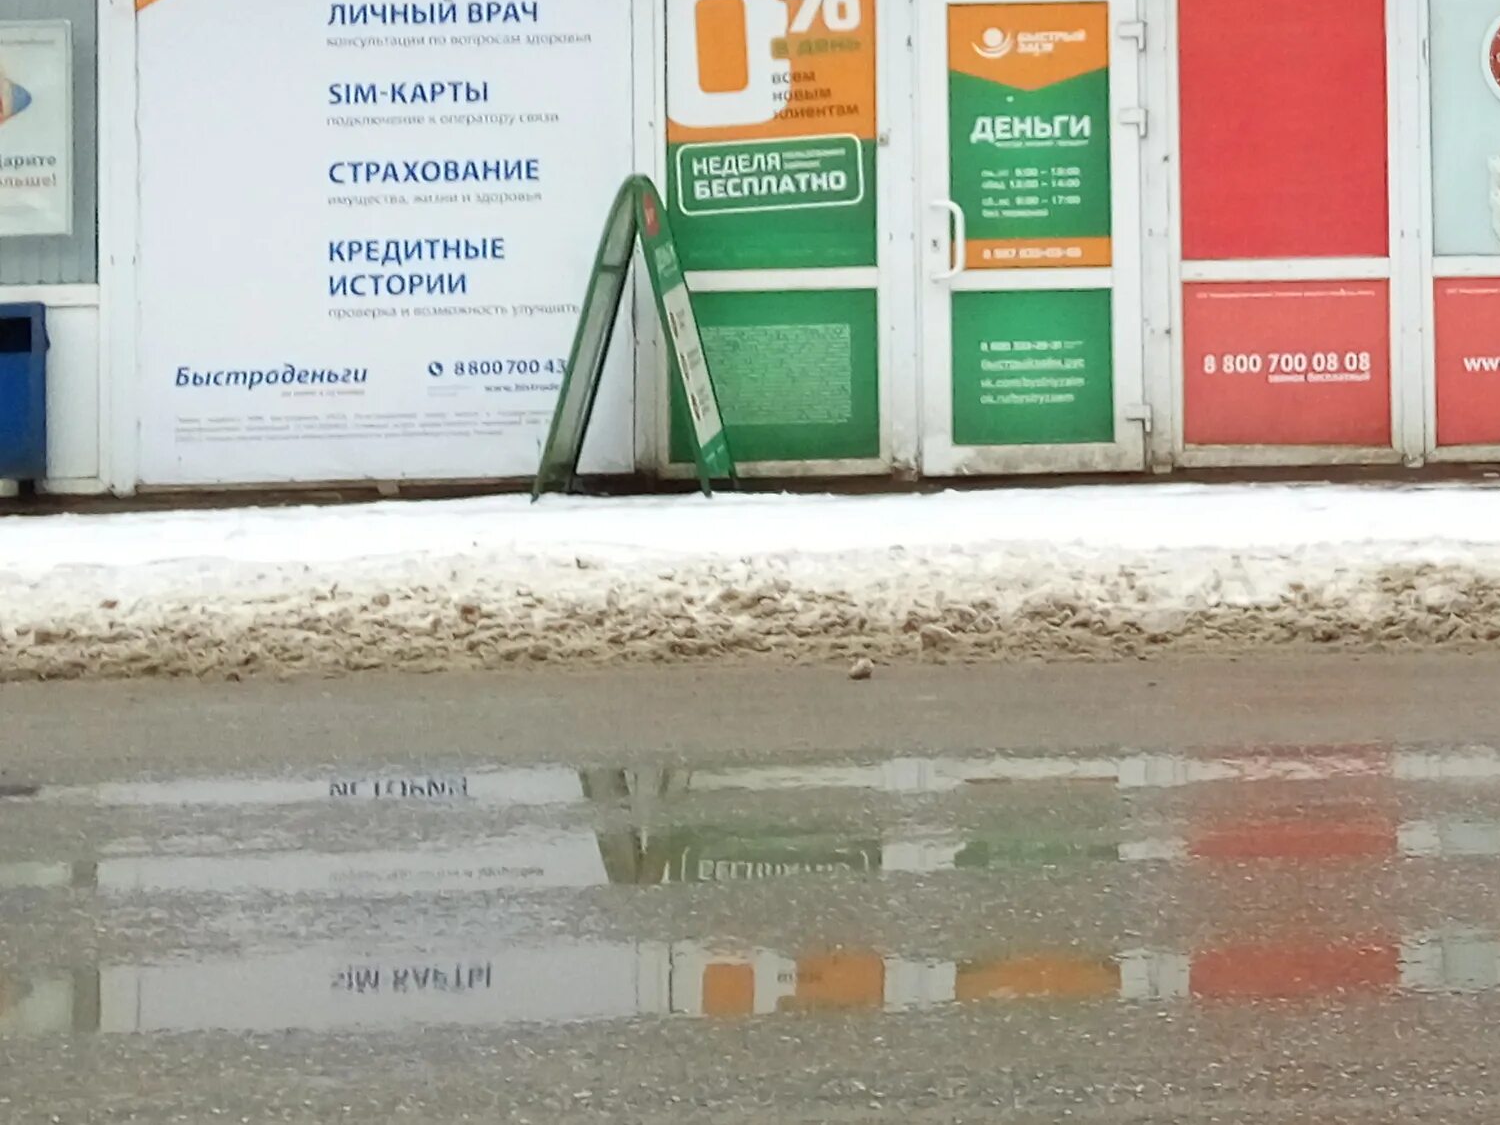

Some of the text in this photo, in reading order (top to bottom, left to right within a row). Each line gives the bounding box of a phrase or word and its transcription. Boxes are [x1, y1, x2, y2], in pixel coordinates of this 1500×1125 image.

[468, 1, 538, 23] ВРАЧ
[328, 81, 489, 105] SIM-КАРТЫ
[970, 115, 1091, 143] ДЕНЬГИ
[328, 159, 540, 184] СТРАХОВАНИЕ
[692, 152, 781, 177] НЕДЕЛЯ
[694, 170, 847, 200] БЕСПЛАТНО
[328, 238, 505, 267] КРЕДИТНЫЕ
[329, 273, 467, 297] ИСТОРИИ
[1203, 351, 1371, 374] 8 800 700 08 08
[176, 363, 368, 391] Быстроденьги
